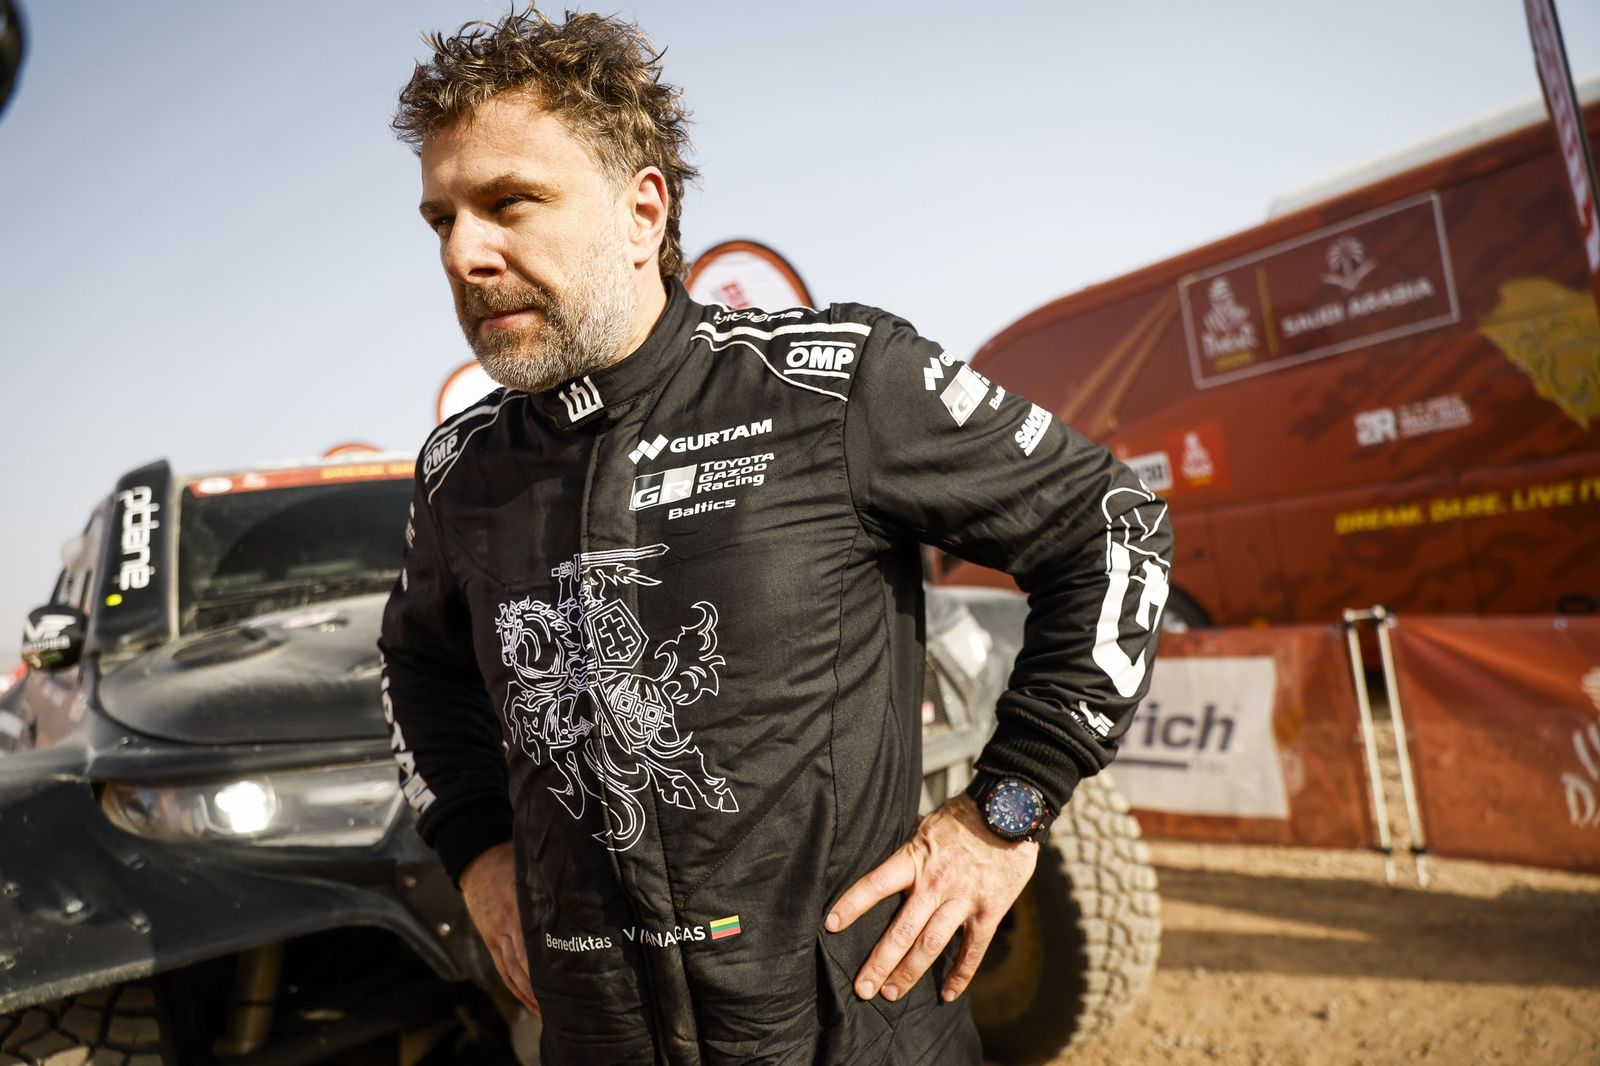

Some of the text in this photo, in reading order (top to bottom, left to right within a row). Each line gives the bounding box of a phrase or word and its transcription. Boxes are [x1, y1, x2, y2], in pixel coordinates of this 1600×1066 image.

[786, 346, 855, 371] OMP
[669, 418, 773, 453] GURTAM
[423, 434, 458, 475] OMP
[700, 452, 775, 473] TOYOTA
[696, 473, 765, 495] Racing
[698, 462, 768, 484] GAZOO
[633, 480, 692, 509] GR
[1512, 484, 1574, 511] LIVE
[668, 499, 736, 521] Baltics
[545, 932, 613, 953] Benediktas
